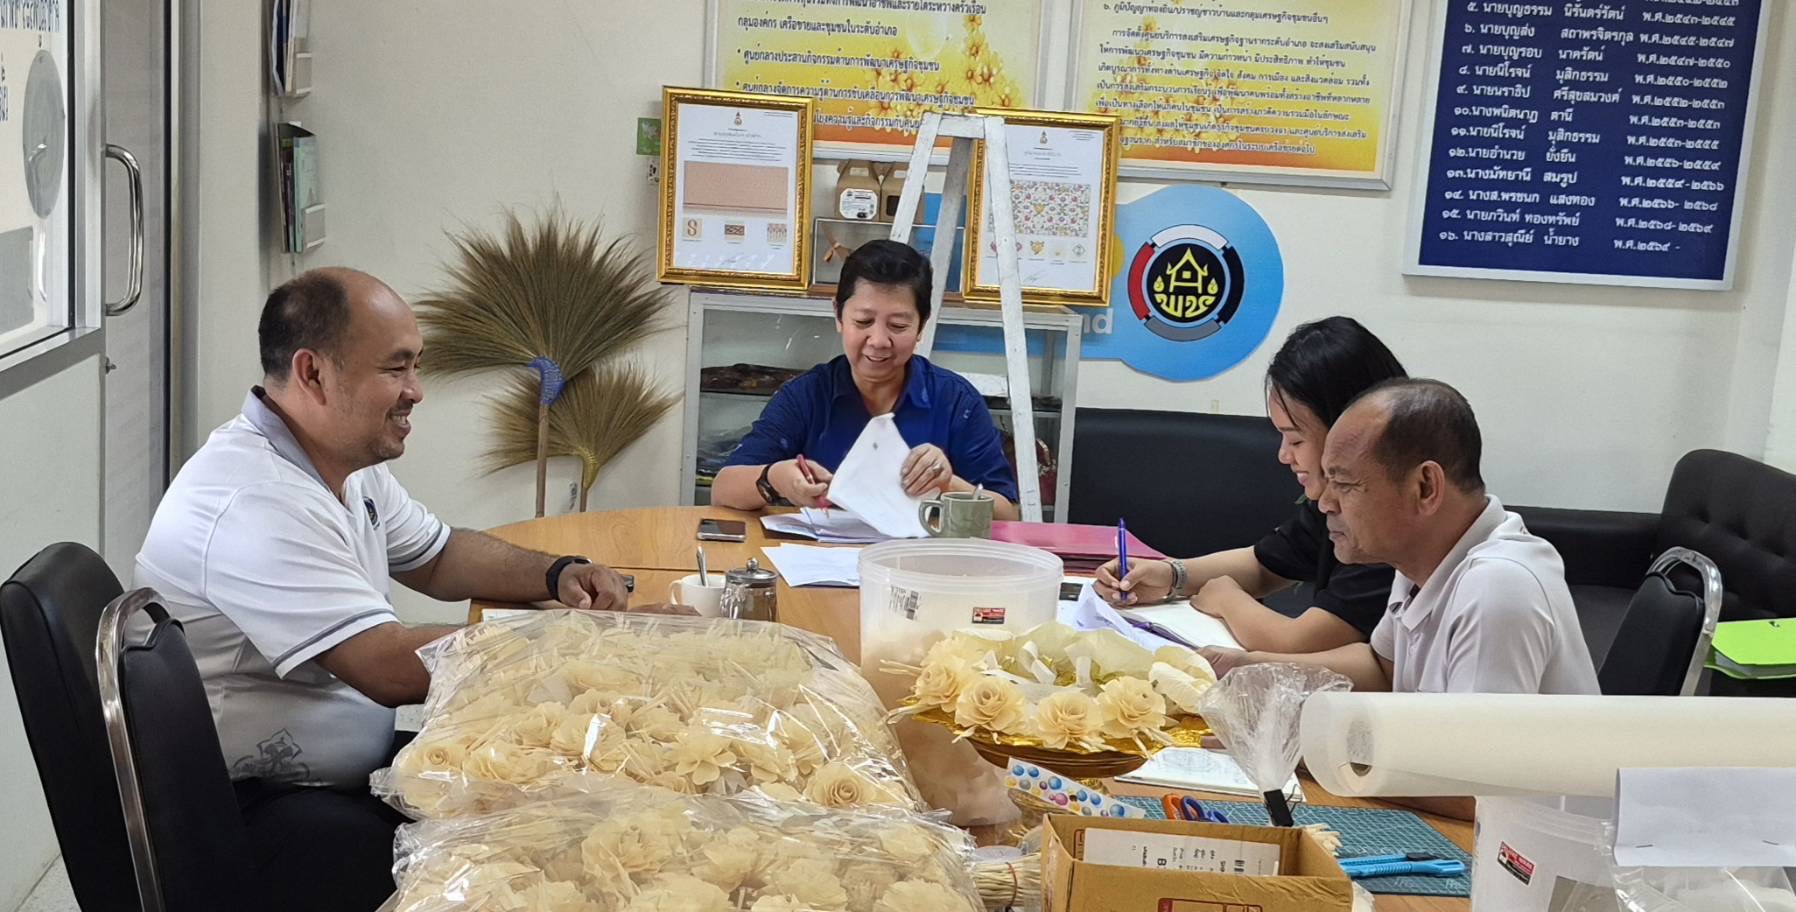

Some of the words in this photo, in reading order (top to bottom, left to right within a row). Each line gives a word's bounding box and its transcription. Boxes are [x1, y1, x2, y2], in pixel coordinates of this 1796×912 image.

[1482, 2, 1553, 18] นายบุญธรรม
[1464, 23, 1476, 33] ๖.
[1479, 22, 1536, 40] นายบุญส่ง
[1560, 26, 1634, 47] สถาพรจิตรกุล
[1461, 43, 1475, 54] ๗.
[1479, 44, 1543, 60] นายบุญรอบ
[1558, 45, 1606, 61] นาครัตน์
[1474, 60, 1533, 78] นายนิโรจน์
[1555, 66, 1609, 85] มุสิกธรรม
[1472, 83, 1531, 98] นายนราธิป
[1553, 86, 1623, 105] ศรีสุขสมวงศ์
[1547, 129, 1601, 145] มุสิกธรรม
[1545, 145, 1577, 163] ยั่งยืน
[1543, 171, 1578, 188] สมรูป
[1468, 189, 1540, 203] นางส.พรชนก
[1549, 194, 1596, 207] แสงทอง
[1465, 208, 1521, 223] นายภวินท์
[1524, 211, 1581, 226] ทองทรัพย์
[1543, 227, 1580, 247] น้ำยาง
